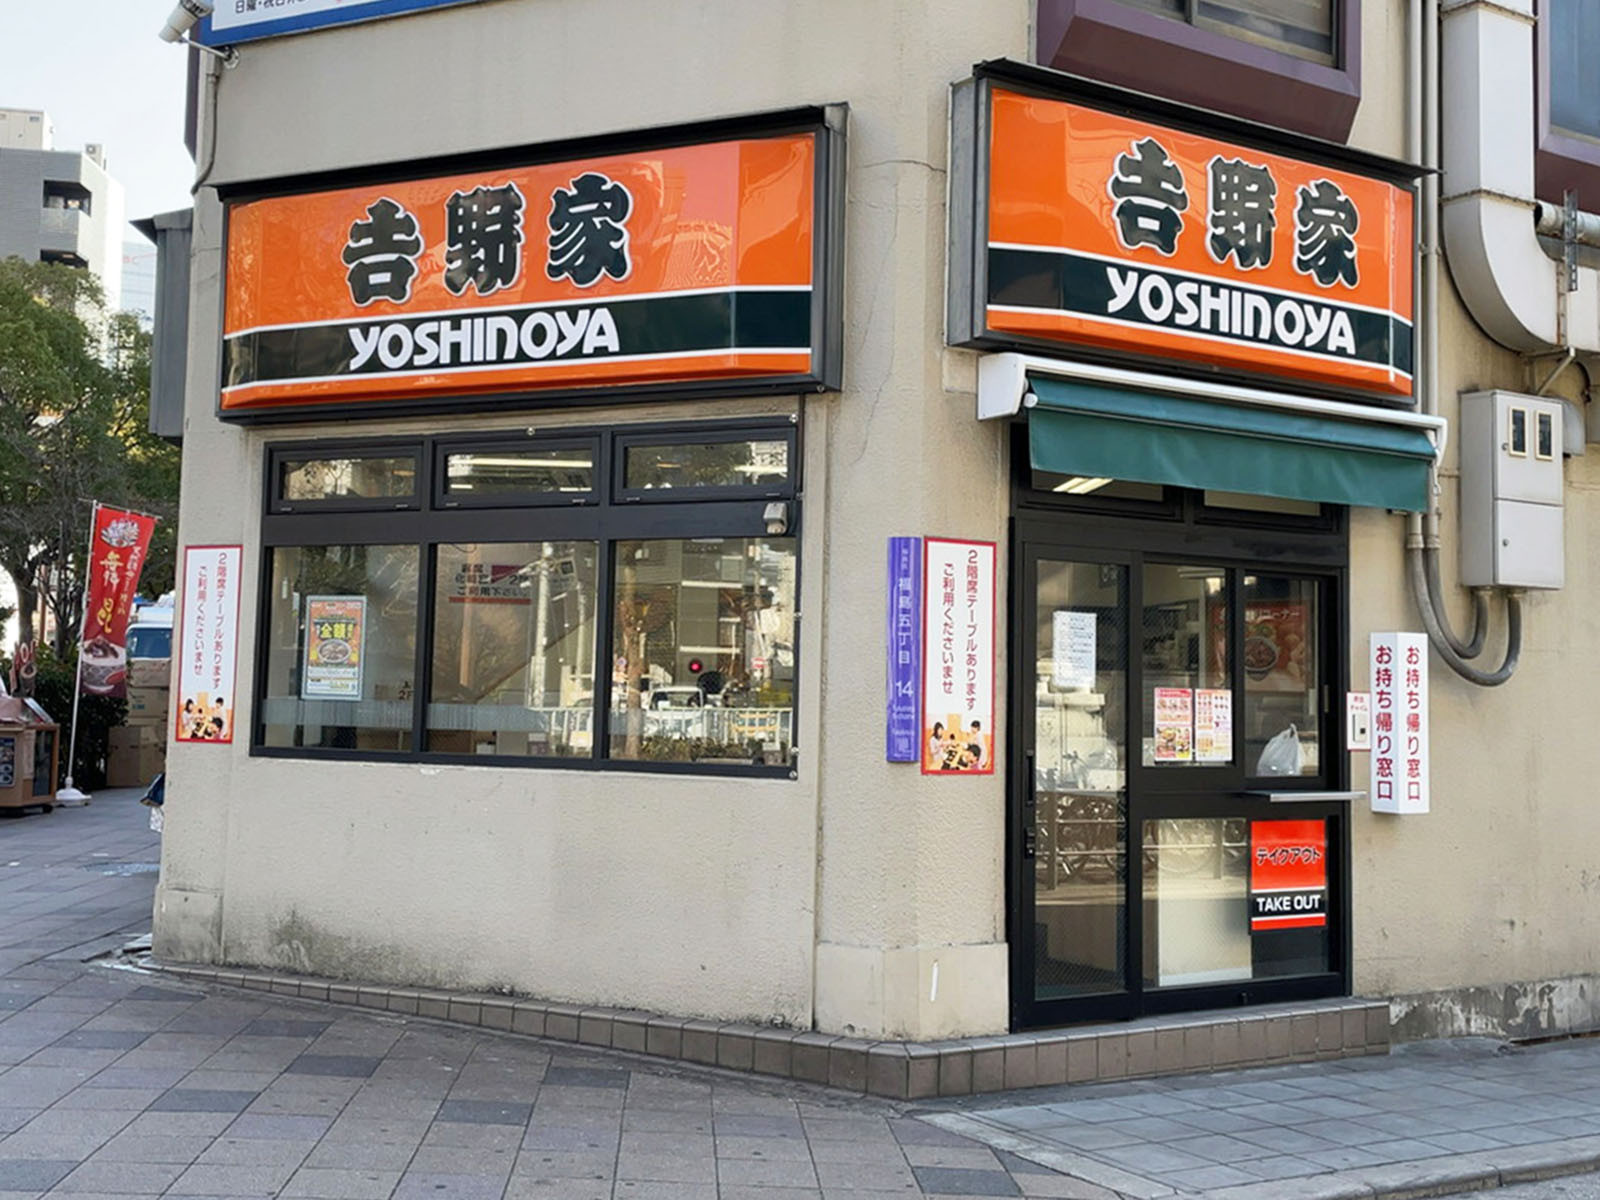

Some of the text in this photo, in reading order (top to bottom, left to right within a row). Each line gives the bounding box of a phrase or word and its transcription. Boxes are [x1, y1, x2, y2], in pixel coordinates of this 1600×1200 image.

[341, 171, 633, 308] 吉野家
[1106, 136, 1359, 289] 吉野家
[348, 307, 620, 371] YOSHINOYA
[1106, 266, 1356, 356] YOSHINOYA
[895, 680, 914, 698] 14
[942, 562, 955, 695] ご利用くださいませ
[966, 549, 978, 711] 2階席テーブルあります
[1376, 645, 1393, 800] お持ち帰り窓口
[1406, 646, 1421, 800] お持ち帰り窓口
[1256, 846, 1321, 866] テイクアウト
[1256, 894, 1321, 912] TAKE OUT
